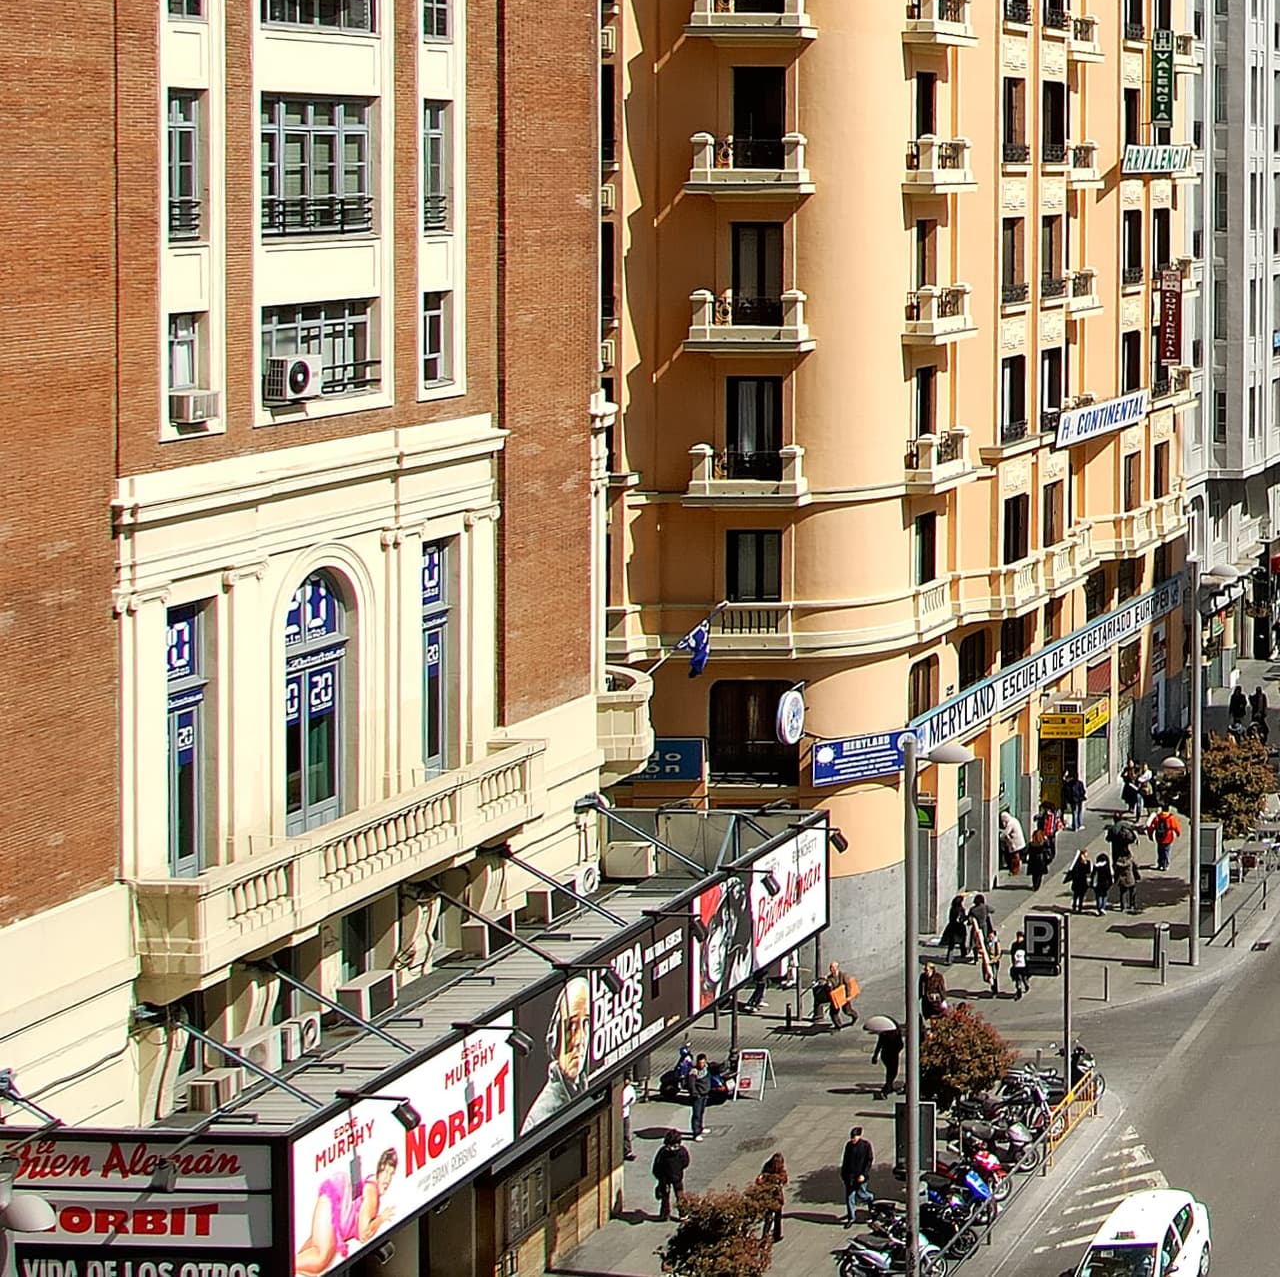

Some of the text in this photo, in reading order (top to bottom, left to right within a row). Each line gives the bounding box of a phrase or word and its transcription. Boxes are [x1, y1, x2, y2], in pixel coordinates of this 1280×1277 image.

[1155, 52, 1169, 119] VALENCIA
[1140, 148, 1189, 170] VALENCIA
[1165, 291, 1176, 358] CONTINENTAL
[1076, 394, 1144, 436] CONTINENTAL
[311, 672, 333, 705] 20
[928, 592, 1169, 747] MERYLAND ESCUELA DE SECRETARIADO EUROPEO
[178, 725, 193, 747] 20
[1025, 920, 1054, 954] P
[593, 971, 643, 1032] DE LOS
[593, 1001, 643, 1061] OTROS
[444, 1042, 497, 1090] MURPHY
[333, 1116, 359, 1140] EDDIE
[404, 1059, 510, 1179] NORBIT
[314, 1119, 376, 1173] MURPHY
[46, 1203, 220, 1237] ORBIT
